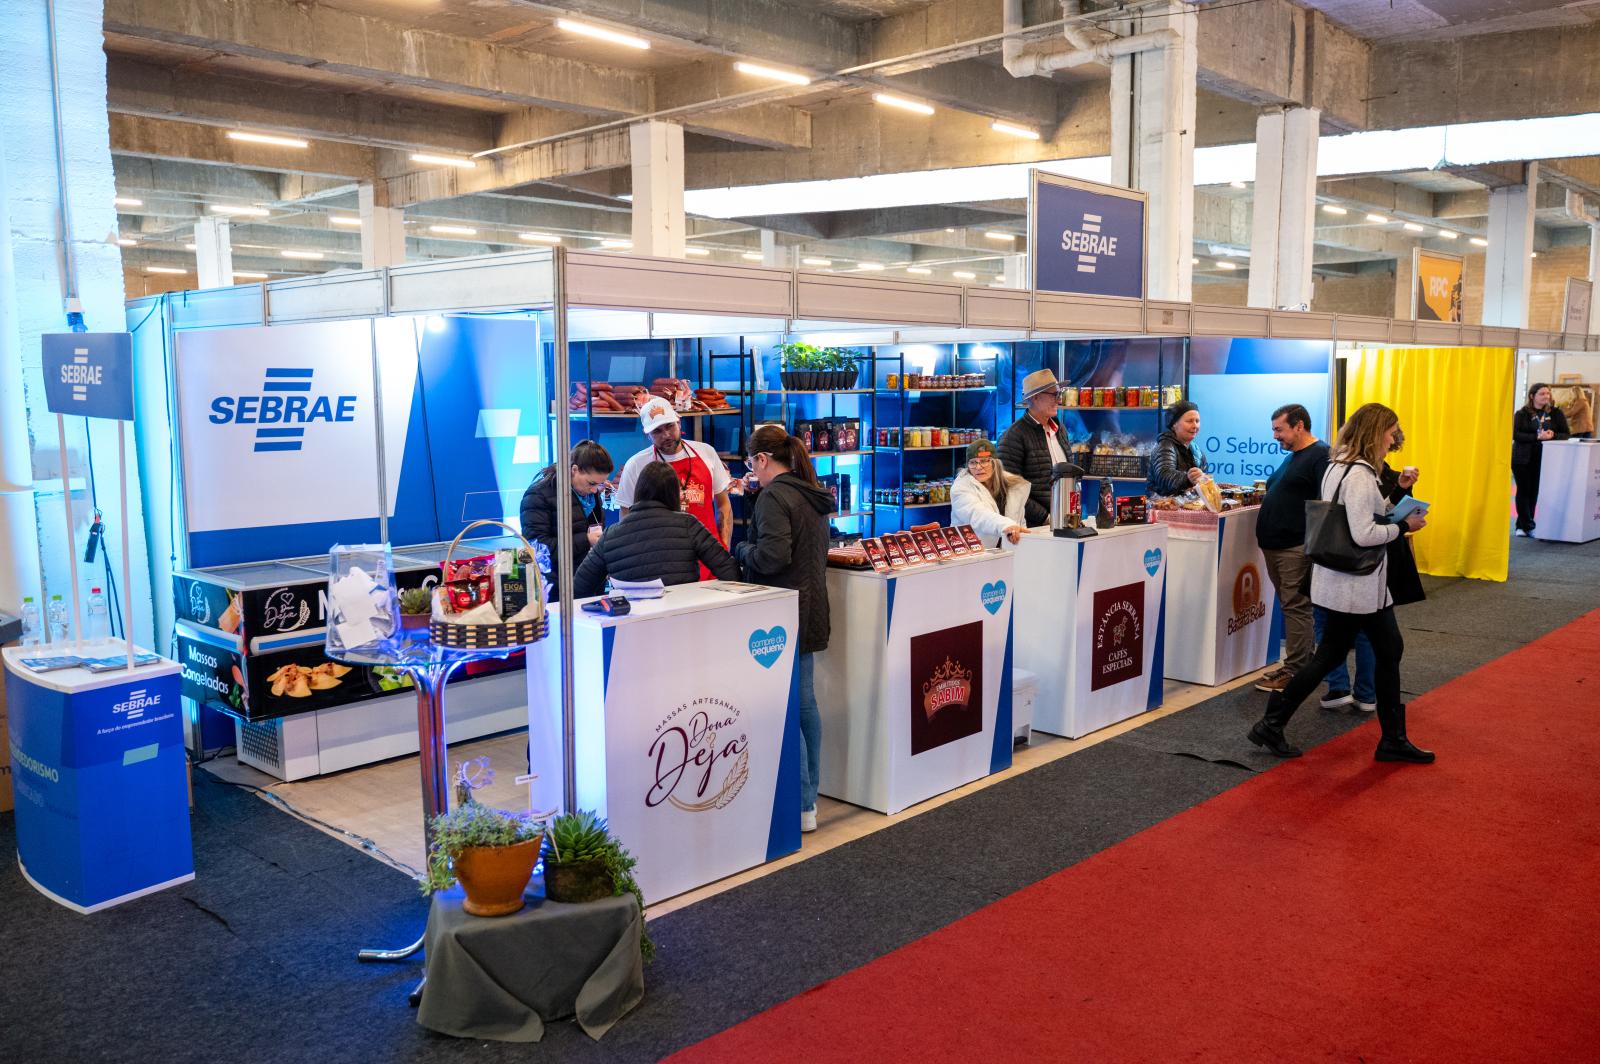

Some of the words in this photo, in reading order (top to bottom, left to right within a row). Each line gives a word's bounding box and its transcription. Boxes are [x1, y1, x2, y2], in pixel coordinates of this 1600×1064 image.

[1061, 229, 1118, 257] SEBRAE
[1429, 276, 1449, 299] RPC
[61, 364, 103, 386] SEBRAE
[208, 395, 358, 425] SEBRAE
[1205, 436, 1221, 453] O
[1240, 459, 1275, 477] isso
[1121, 600, 1140, 640] SERRANA
[751, 637, 776, 649] compre
[775, 633, 785, 644] do
[751, 643, 785, 656] pequeno
[188, 645, 218, 669] Massas
[1102, 656, 1133, 675] ESPECIAIS
[180, 662, 229, 695] Congeladas
[112, 694, 162, 714] SEBRAE
[931, 686, 966, 711] SABIM
[655, 703, 688, 733] MASSAS
[692, 697, 741, 717] ARTESANAIS
[688, 711, 737, 749] Dona
